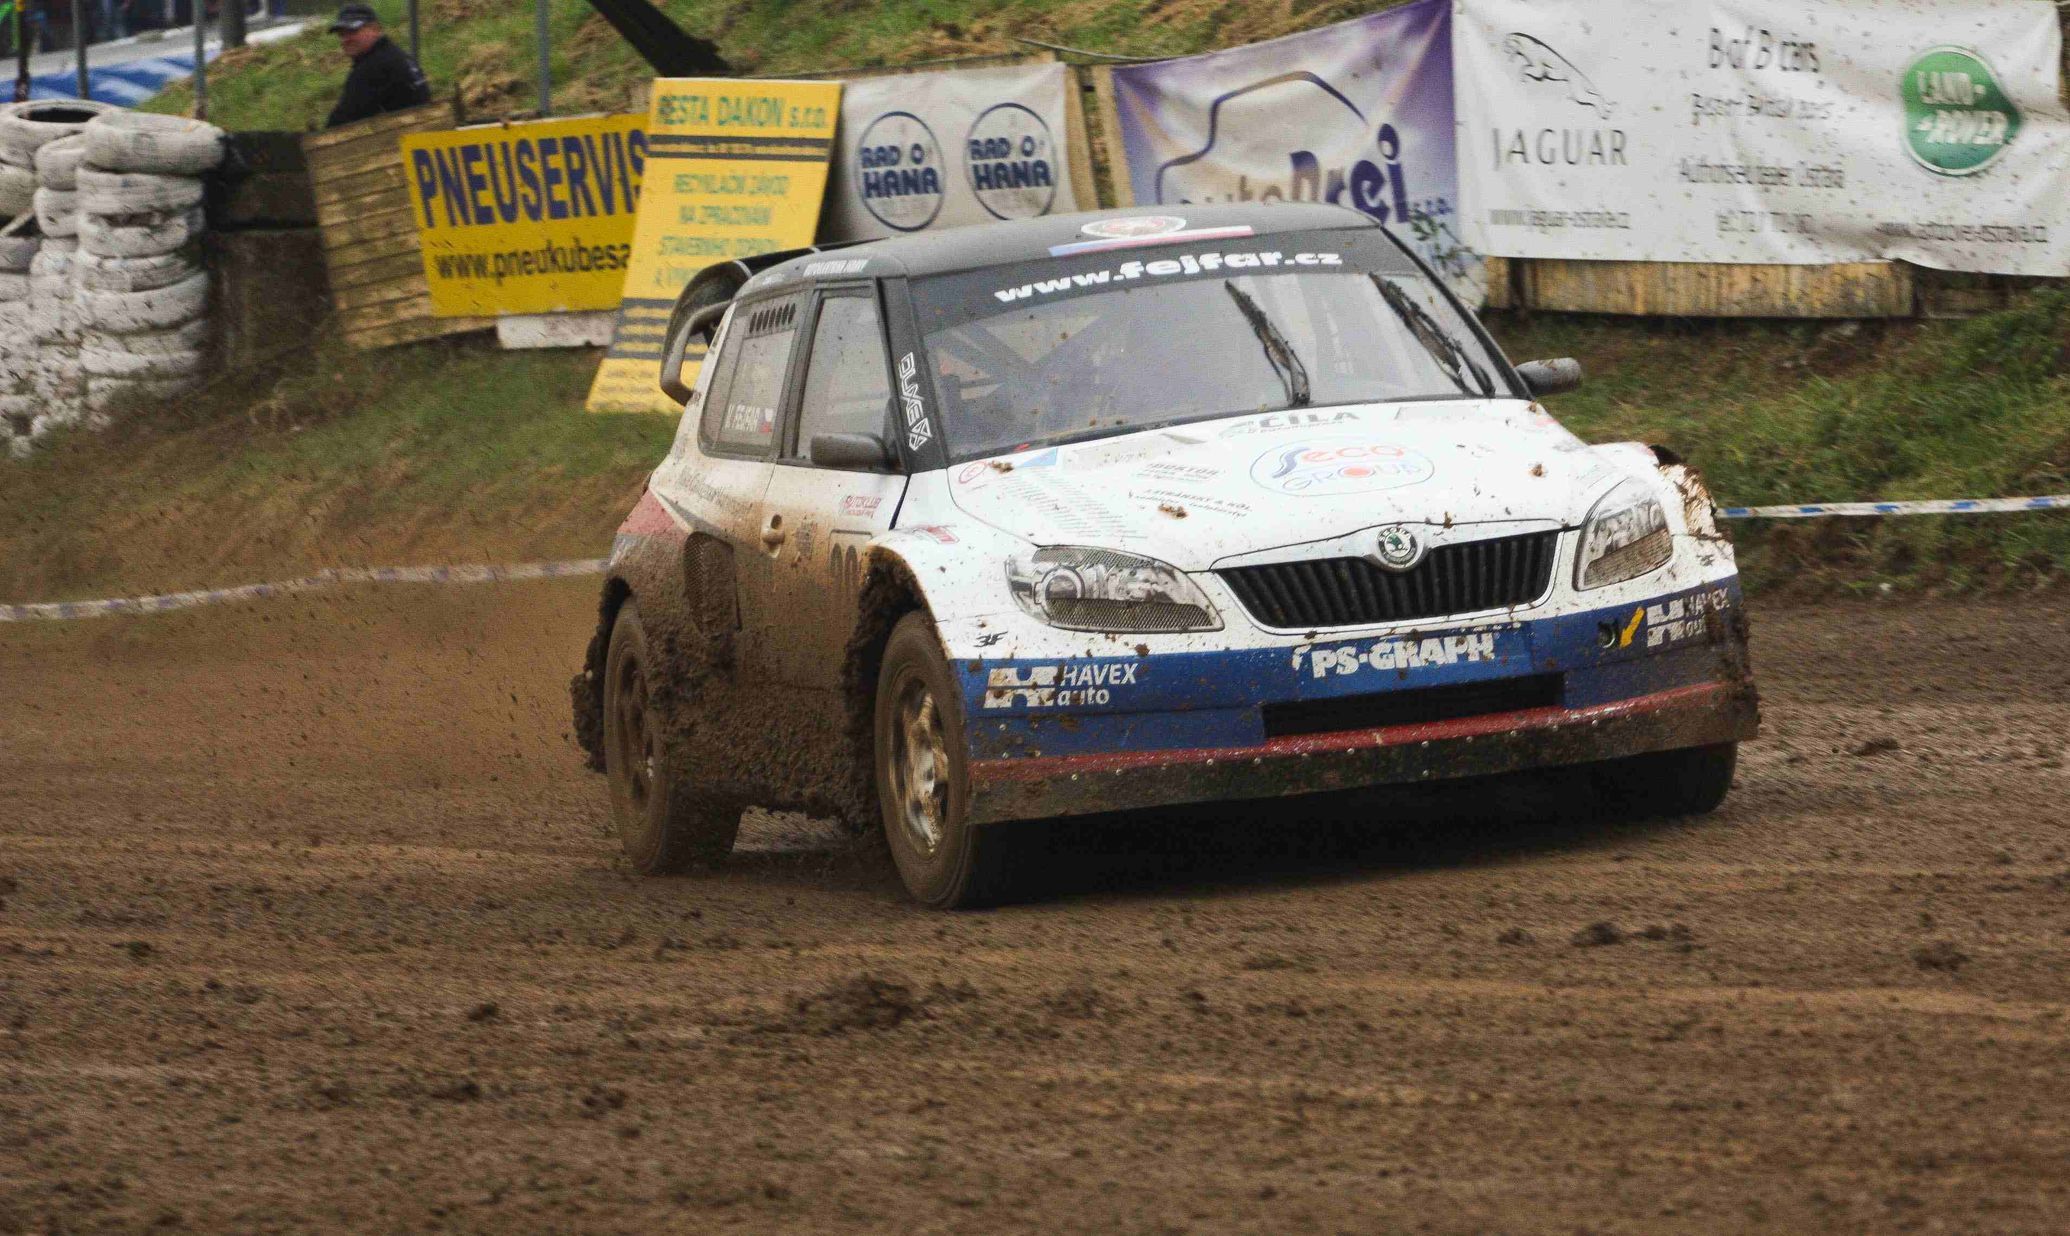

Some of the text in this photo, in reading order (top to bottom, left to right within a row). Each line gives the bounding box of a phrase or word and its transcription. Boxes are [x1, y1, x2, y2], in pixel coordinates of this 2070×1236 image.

[1492, 128, 1628, 171] JAGUAR
[411, 128, 650, 229] PNEUSERVIS
[994, 251, 1343, 302] www.fejfar.cz
[1060, 662, 1139, 687] HAVEX
